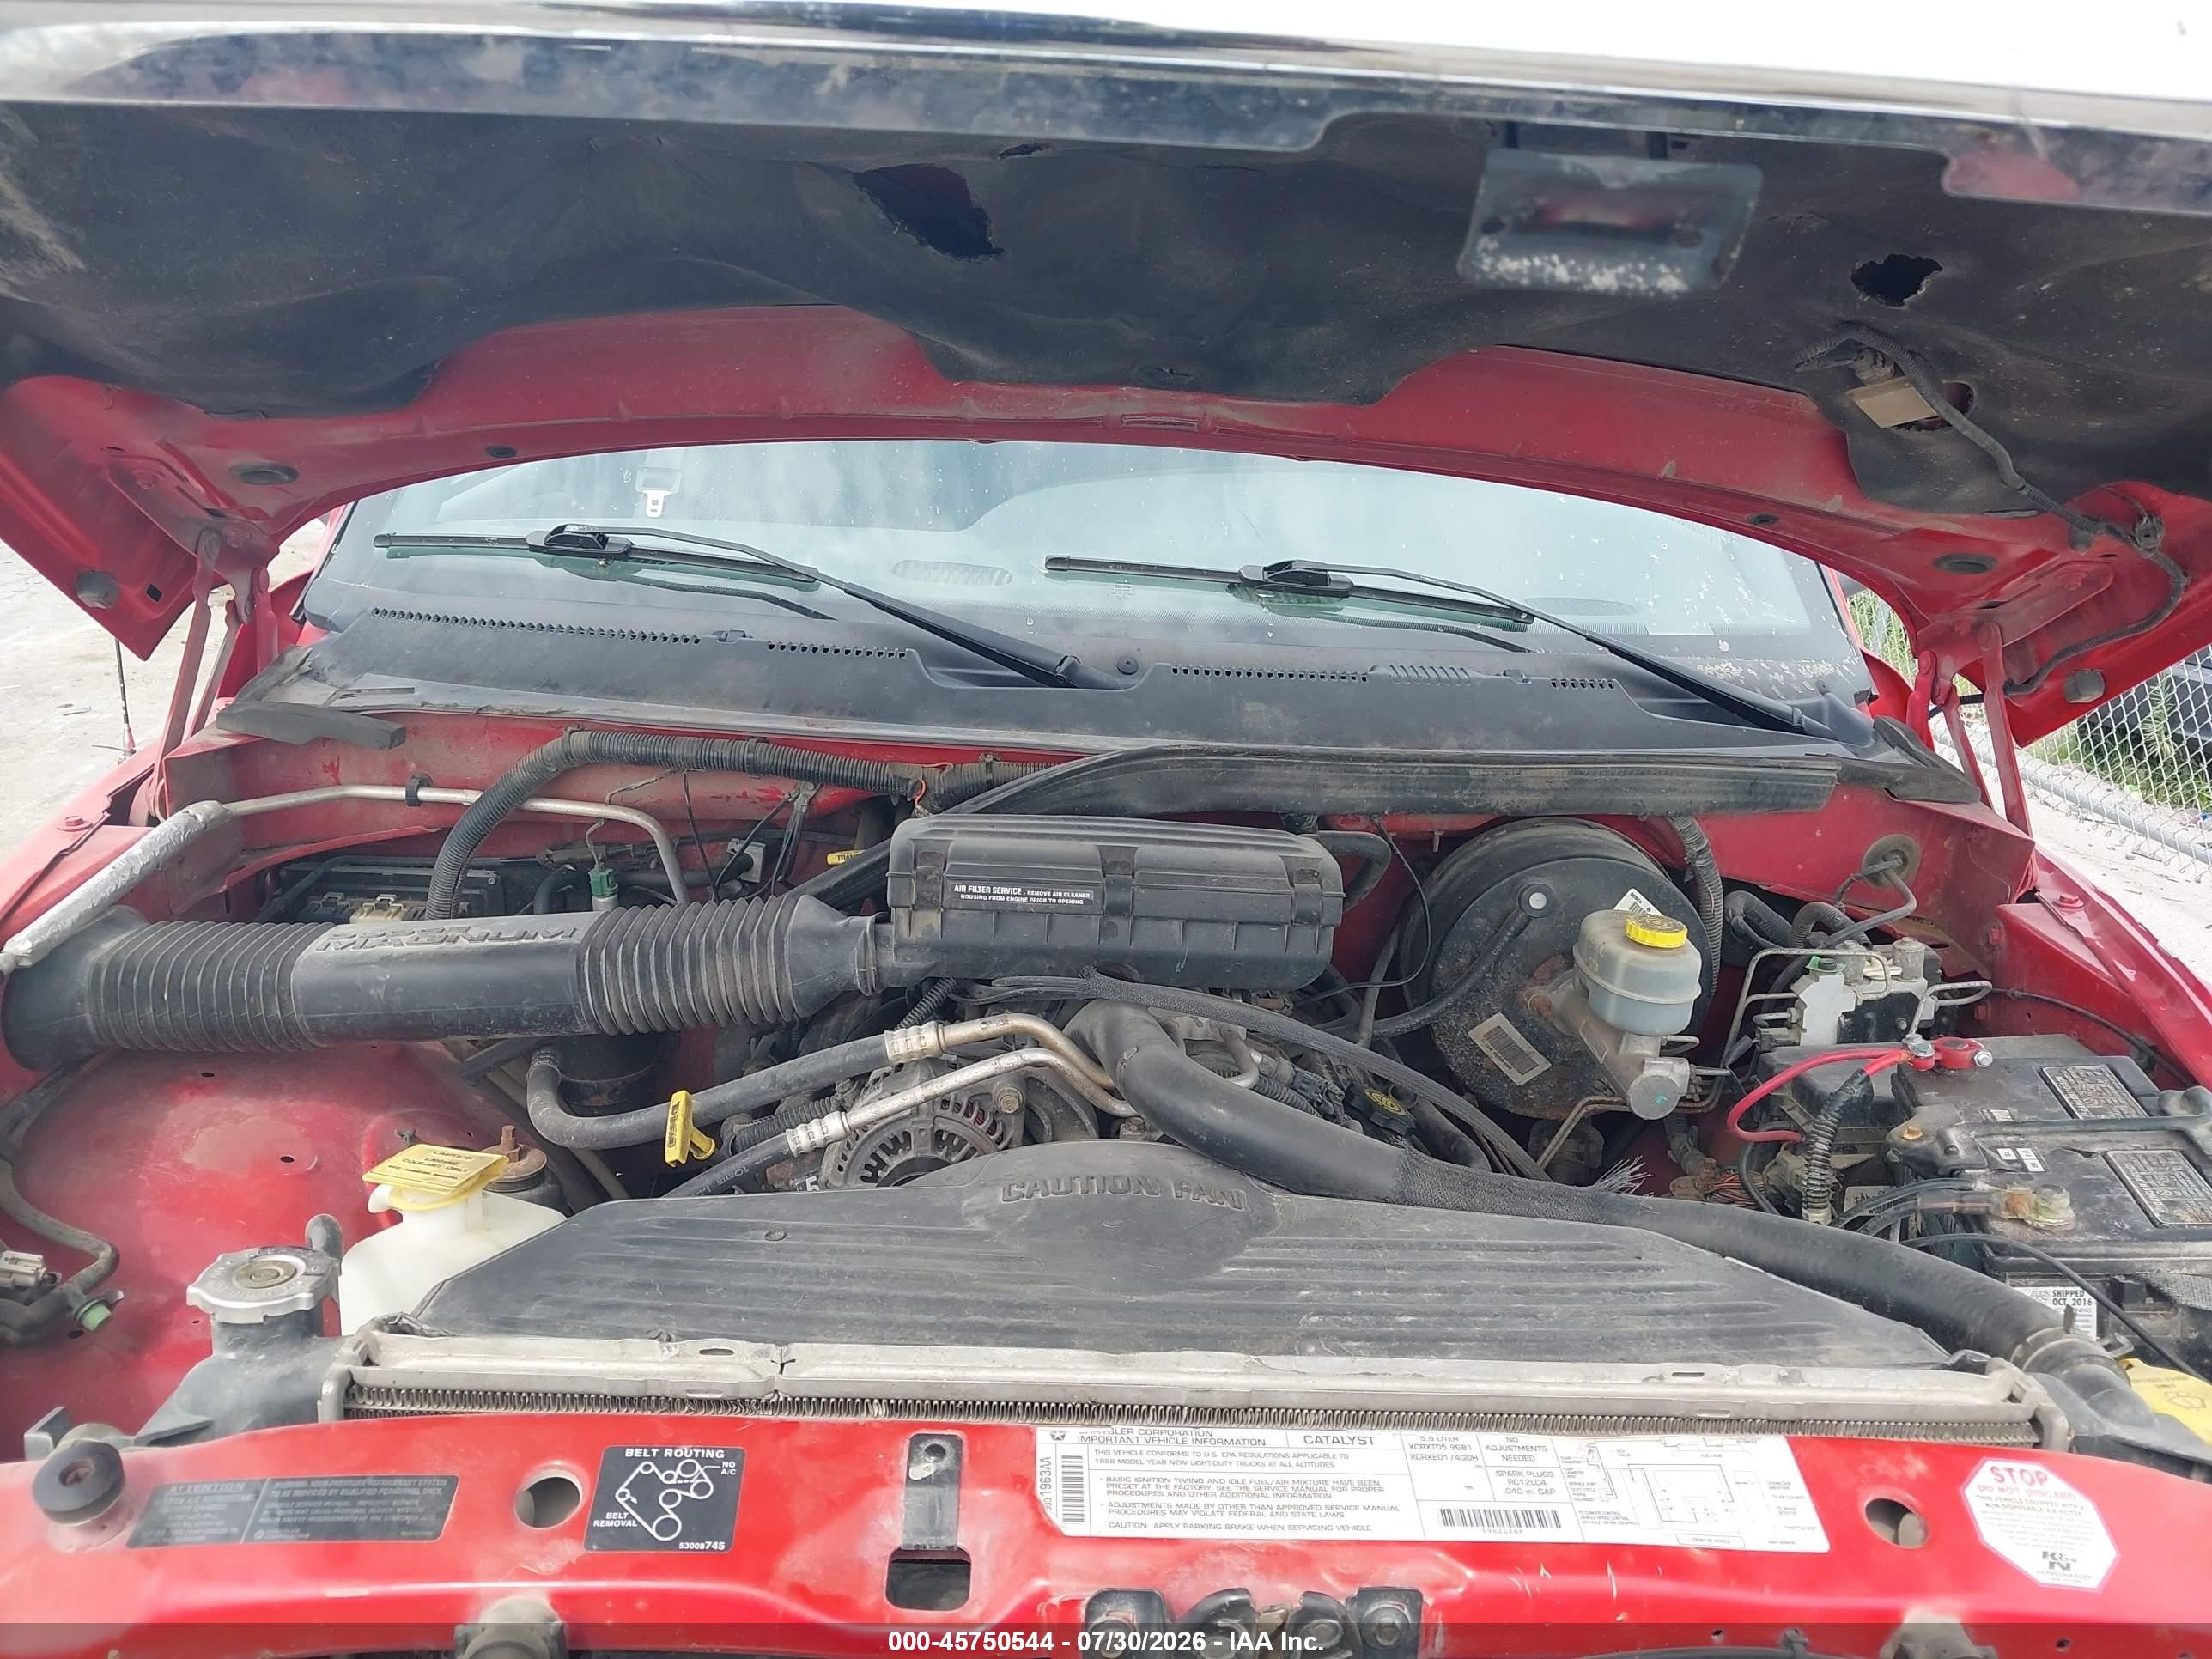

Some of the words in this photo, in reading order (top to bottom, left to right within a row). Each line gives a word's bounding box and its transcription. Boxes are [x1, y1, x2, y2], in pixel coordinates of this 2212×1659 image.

[968, 885, 990, 894] FILTER
[993, 886, 1022, 895] SERVICE
[315, 927, 577, 952] MAGNUM
[1001, 1174, 1160, 1203] CAUTION
[1172, 1181, 1246, 1211] FAN
[1138, 1428, 1213, 1437] CORPORATION
[1078, 1435, 1140, 1443] IMPORTANT
[1304, 1435, 1375, 1445] CATALYST
[625, 1449, 659, 1457] BELT
[664, 1449, 725, 1458] ROUTING
[1990, 1466, 2048, 1486] STOP
[1997, 1486, 2020, 1495] NOT
[2027, 1489, 2076, 1500] DISCARD
[679, 1541, 726, 1550] 53008745
